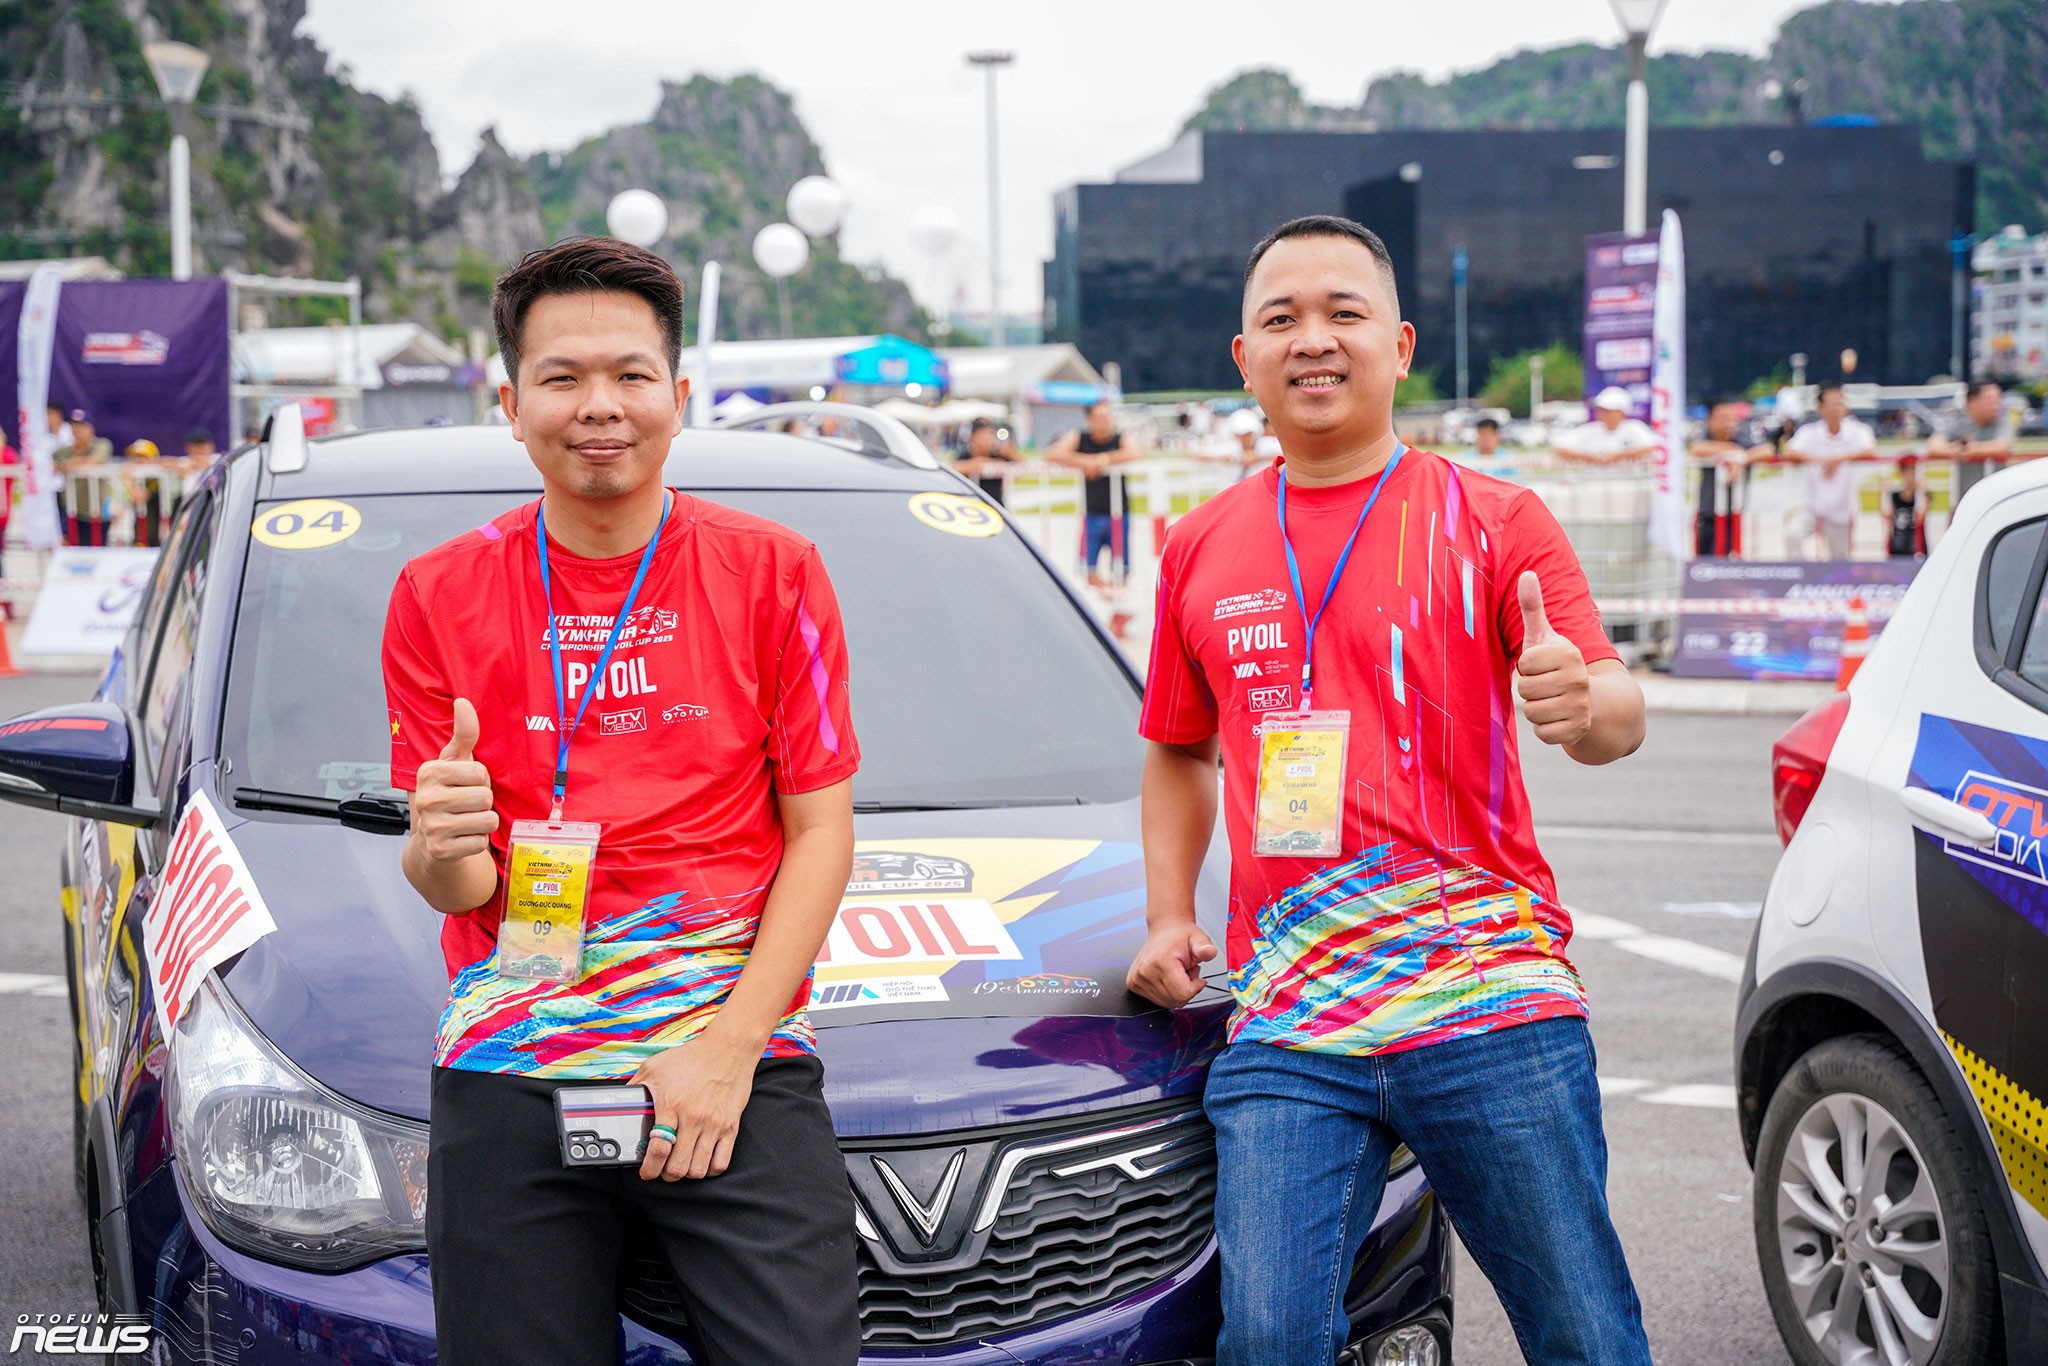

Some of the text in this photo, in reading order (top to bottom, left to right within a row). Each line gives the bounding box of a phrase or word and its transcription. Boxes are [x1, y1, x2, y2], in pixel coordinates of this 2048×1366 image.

[921, 502, 989, 525] 09
[265, 510, 348, 535] 04
[1214, 600, 1264, 616] GYMKHANA
[1216, 593, 1252, 607] VIETNAM
[540, 643, 605, 652] CHMPIONSHIP
[653, 635, 673, 643] 2025
[1227, 622, 1288, 655] PVOIL
[568, 656, 657, 700] PVOIL
[1252, 698, 1291, 709] MEDIA
[603, 720, 646, 733] MEDIA
[1289, 799, 1308, 813] 04
[543, 882, 559, 892] PVOIL
[881, 881, 919, 889] CUP
[149, 805, 252, 1028] PVOIL
[533, 920, 552, 936] 09
[1000, 982, 1100, 998] Anniversary
